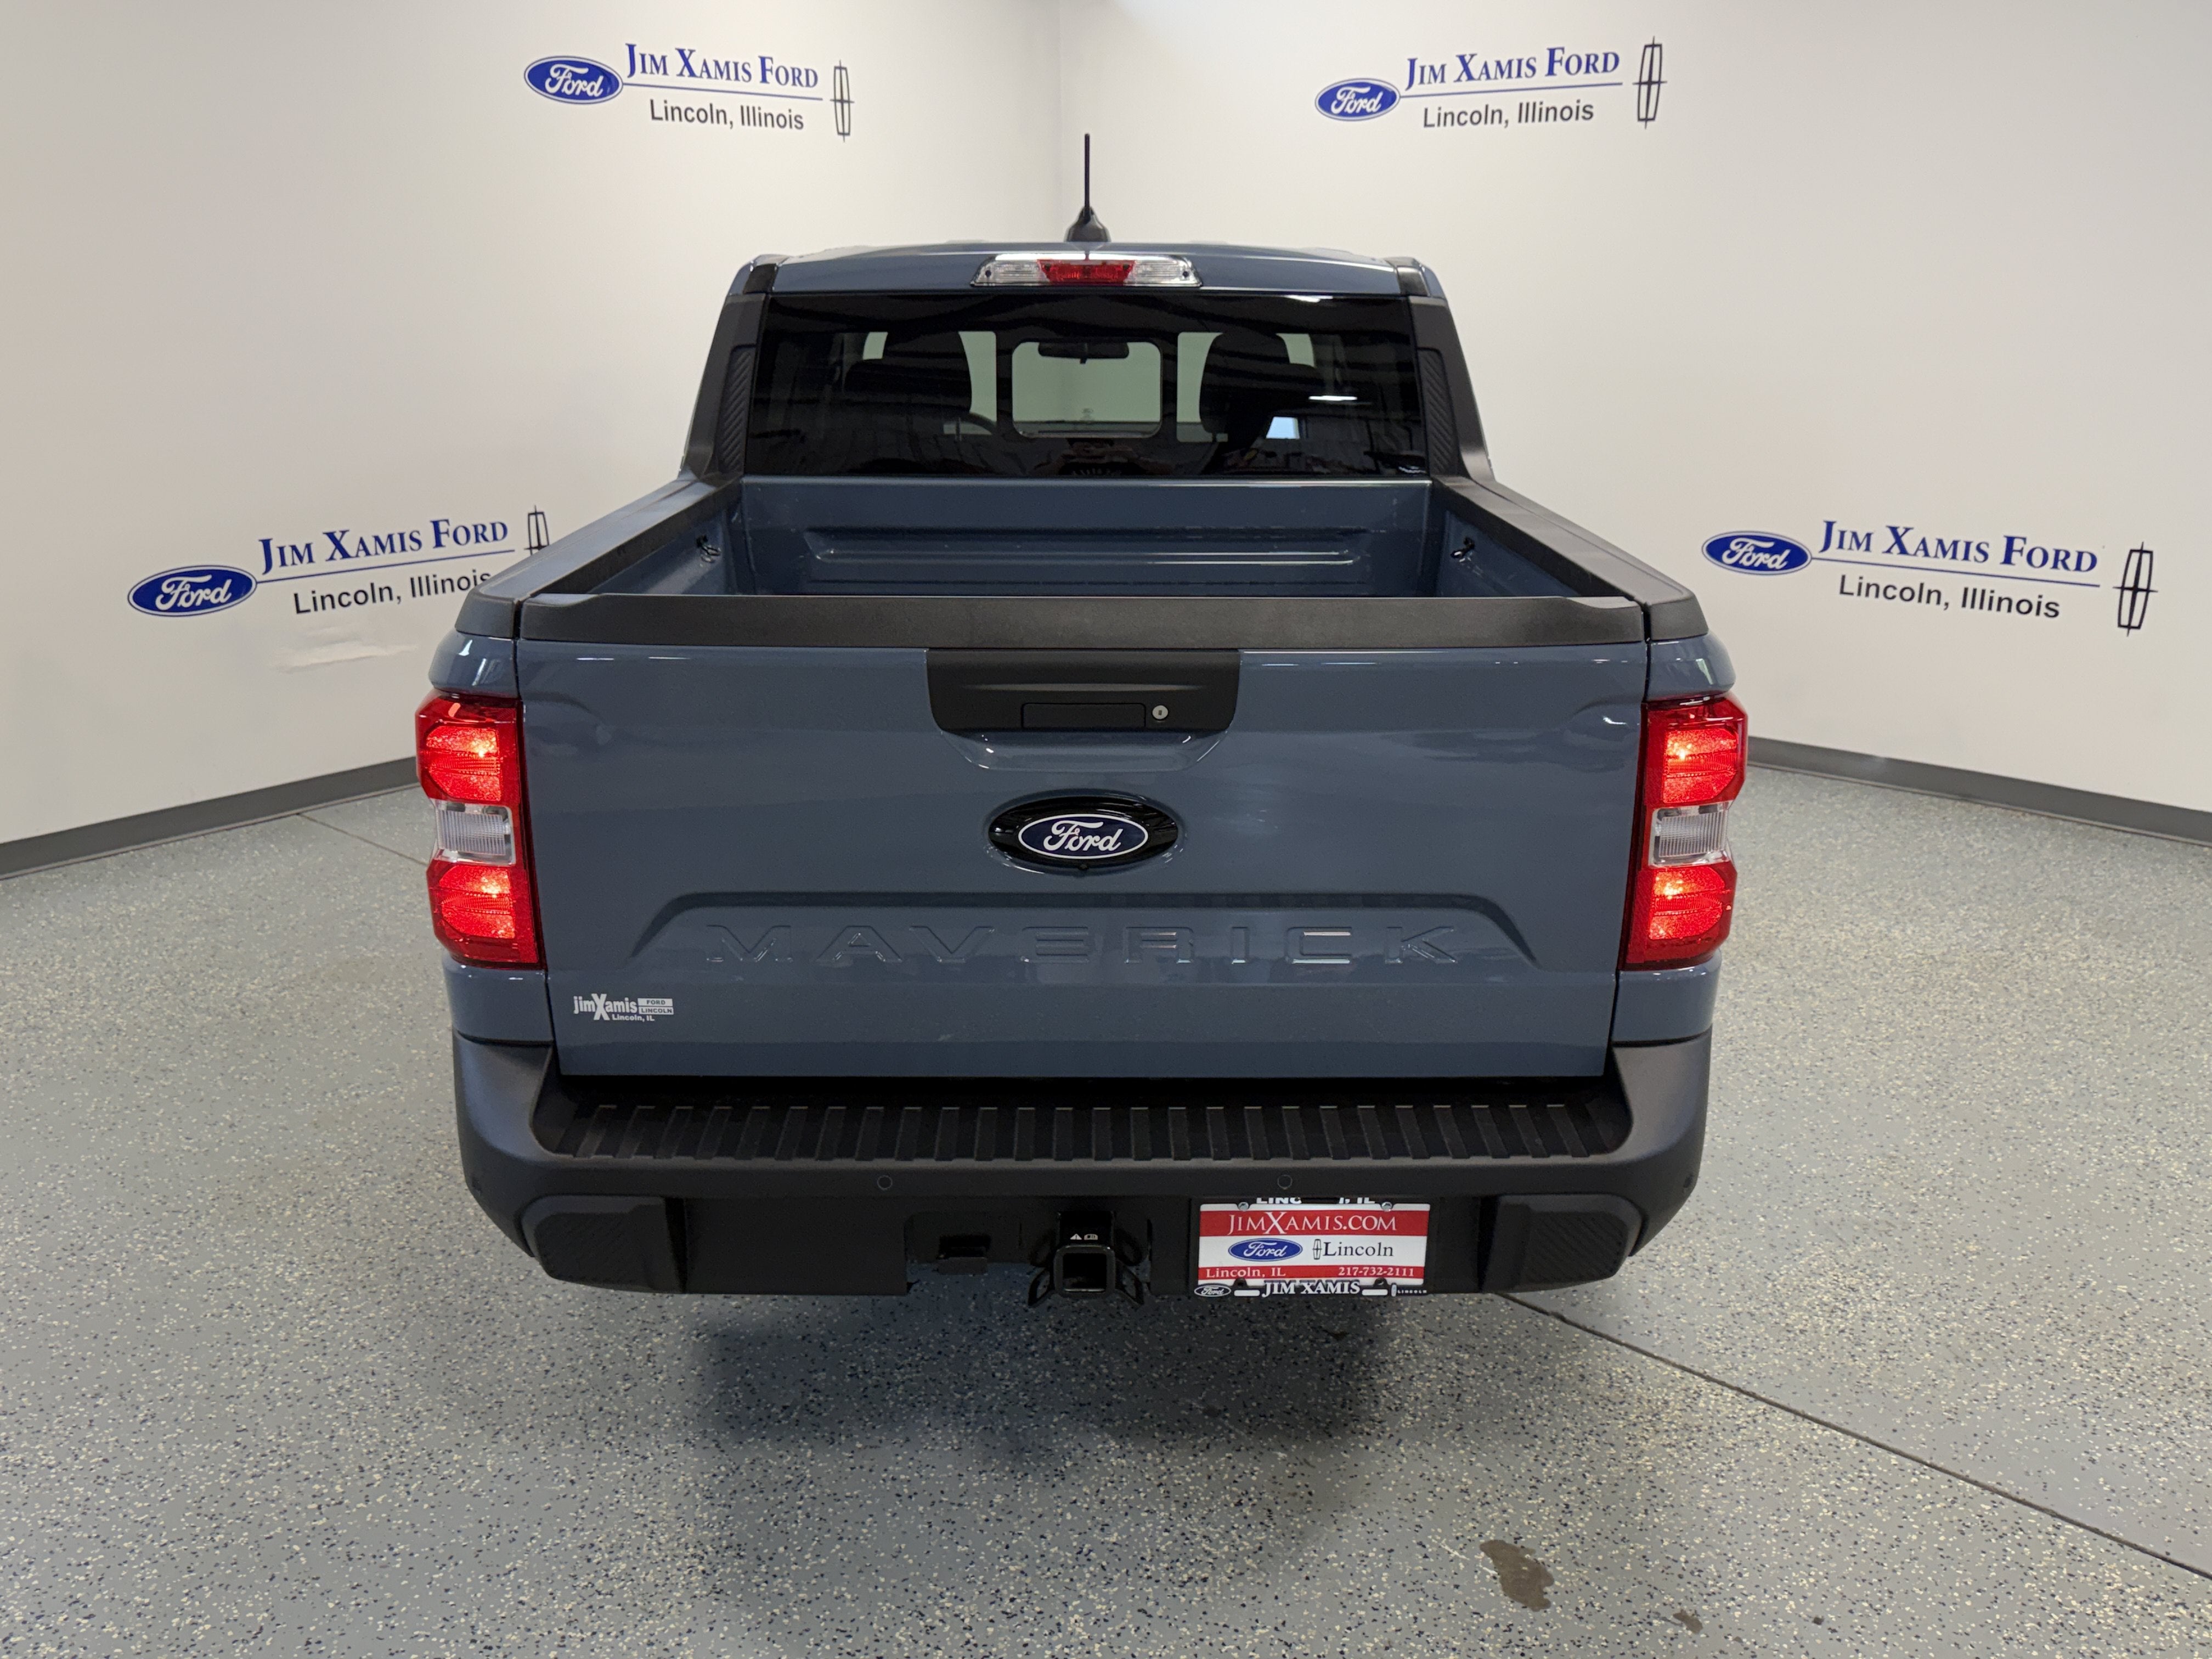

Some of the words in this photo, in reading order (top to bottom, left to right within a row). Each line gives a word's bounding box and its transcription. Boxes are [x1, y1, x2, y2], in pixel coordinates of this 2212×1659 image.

[545, 64, 603, 97] Ford
[625, 43, 668, 78] JIM
[675, 48, 752, 83] XAMIS
[758, 55, 818, 88] FORD
[1405, 58, 1447, 91] JIM
[1454, 53, 1537, 82] XAMIS
[1545, 47, 1620, 77] FORD
[651, 99, 733, 129] Lincoln,
[741, 105, 804, 130] Illinois
[1331, 86, 1381, 114] Ford
[1424, 104, 1509, 128] Lincoln,
[1517, 99, 1594, 123] Illinois
[258, 538, 315, 575] JIM
[323, 529, 422, 562] XAMIS
[430, 519, 508, 549] FORD
[1722, 537, 1790, 569] Ford
[1819, 520, 1874, 553] JIM
[1882, 526, 1990, 564] XAMIS
[2000, 535, 2097, 573] FORD
[155, 574, 231, 610] Ford
[294, 583, 401, 614] Lincoln,
[1839, 574, 1950, 611] Lincoln,
[1961, 587, 2060, 619] Illinois
[1043, 820, 1124, 851] Ford
[705, 924, 1458, 964] MAVERICK
[612, 1014, 645, 1022] Lincoln,
[1227, 1211, 1397, 1235] JIMXAMIS.COM
[1243, 1242, 1286, 1257] Ford
[1323, 1242, 1393, 1256] Lincoln
[1206, 1267, 1265, 1278] Lincoln,
[1271, 1267, 1286, 1277] IL
[1338, 1267, 1414, 1277] 217-732-2111
[1200, 1286, 1224, 1295] Ford
[1262, 1281, 1296, 1297] JIM
[1301, 1281, 1360, 1295] XAMIS
